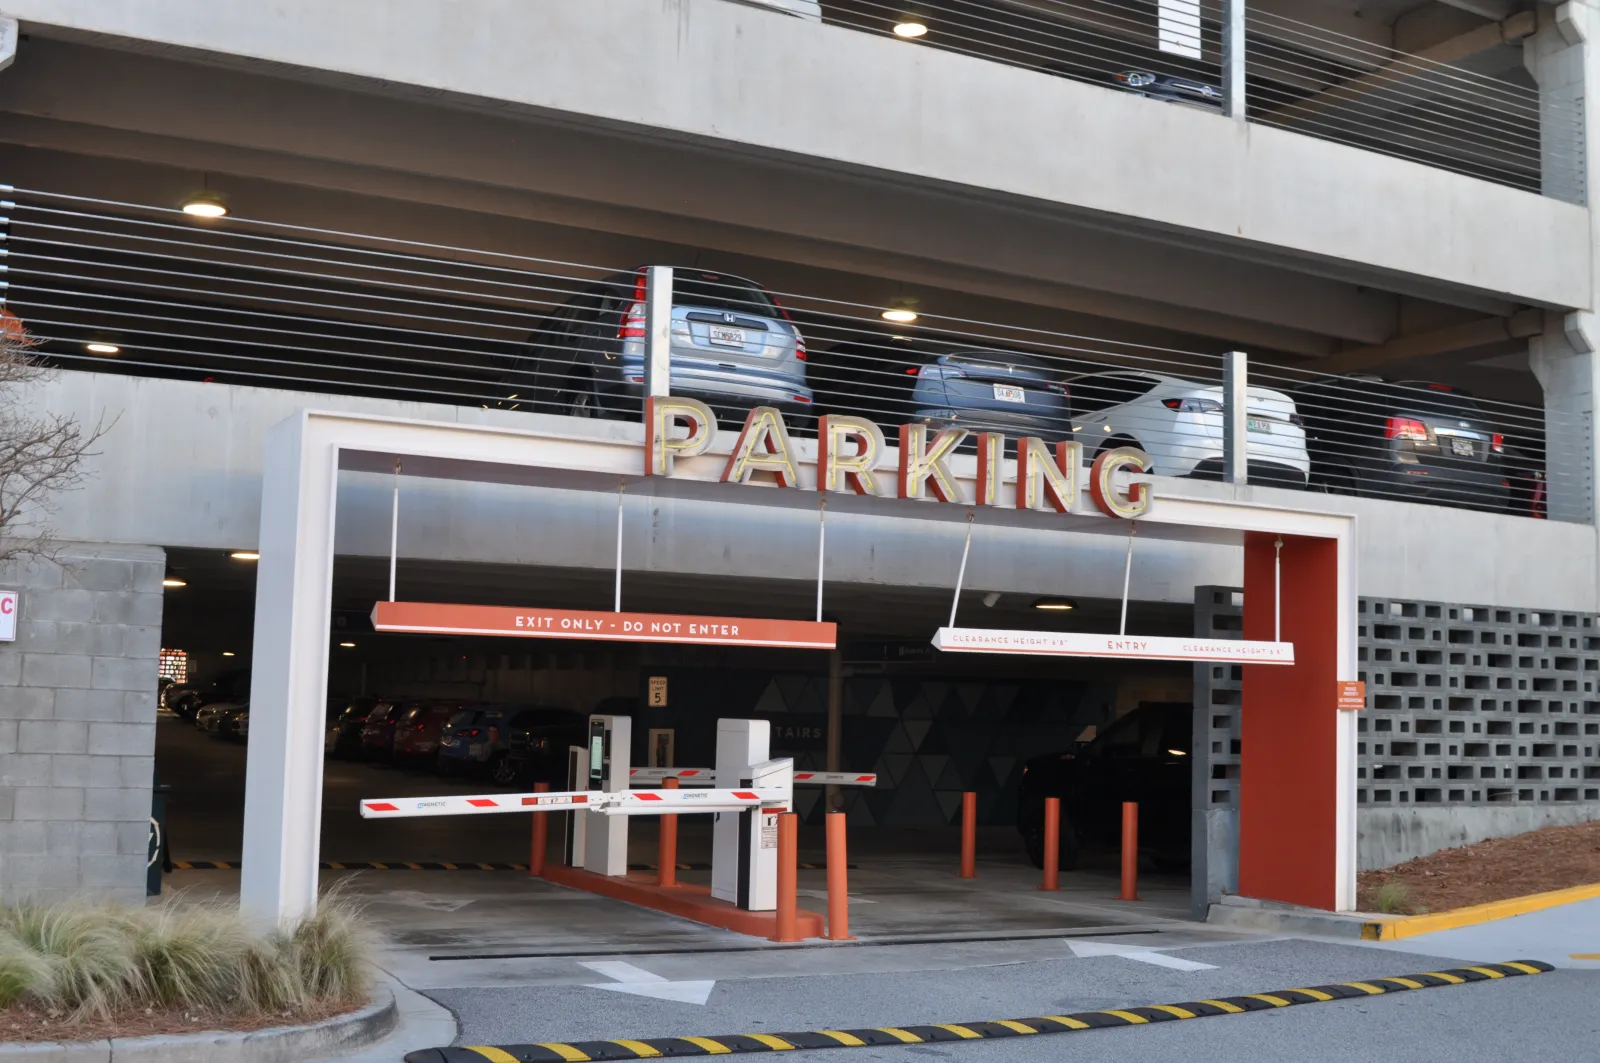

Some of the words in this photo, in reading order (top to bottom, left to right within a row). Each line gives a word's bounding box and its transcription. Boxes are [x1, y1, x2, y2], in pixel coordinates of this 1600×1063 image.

[645, 396, 1154, 519] PARKING
[515, 616, 553, 628] EXIT
[561, 618, 604, 630] ONLY
[623, 621, 643, 632] DO
[651, 622, 682, 633] NOT
[689, 623, 739, 635] ENTER
[952, 634, 1009, 644] CLEARANCE
[1013, 637, 1048, 645] HEIGHT
[1107, 640, 1147, 650] ENTRY
[1182, 645, 1232, 653] CLEARANCE
[655, 692, 662, 703] 5
[769, 726, 822, 739] TAIRS
